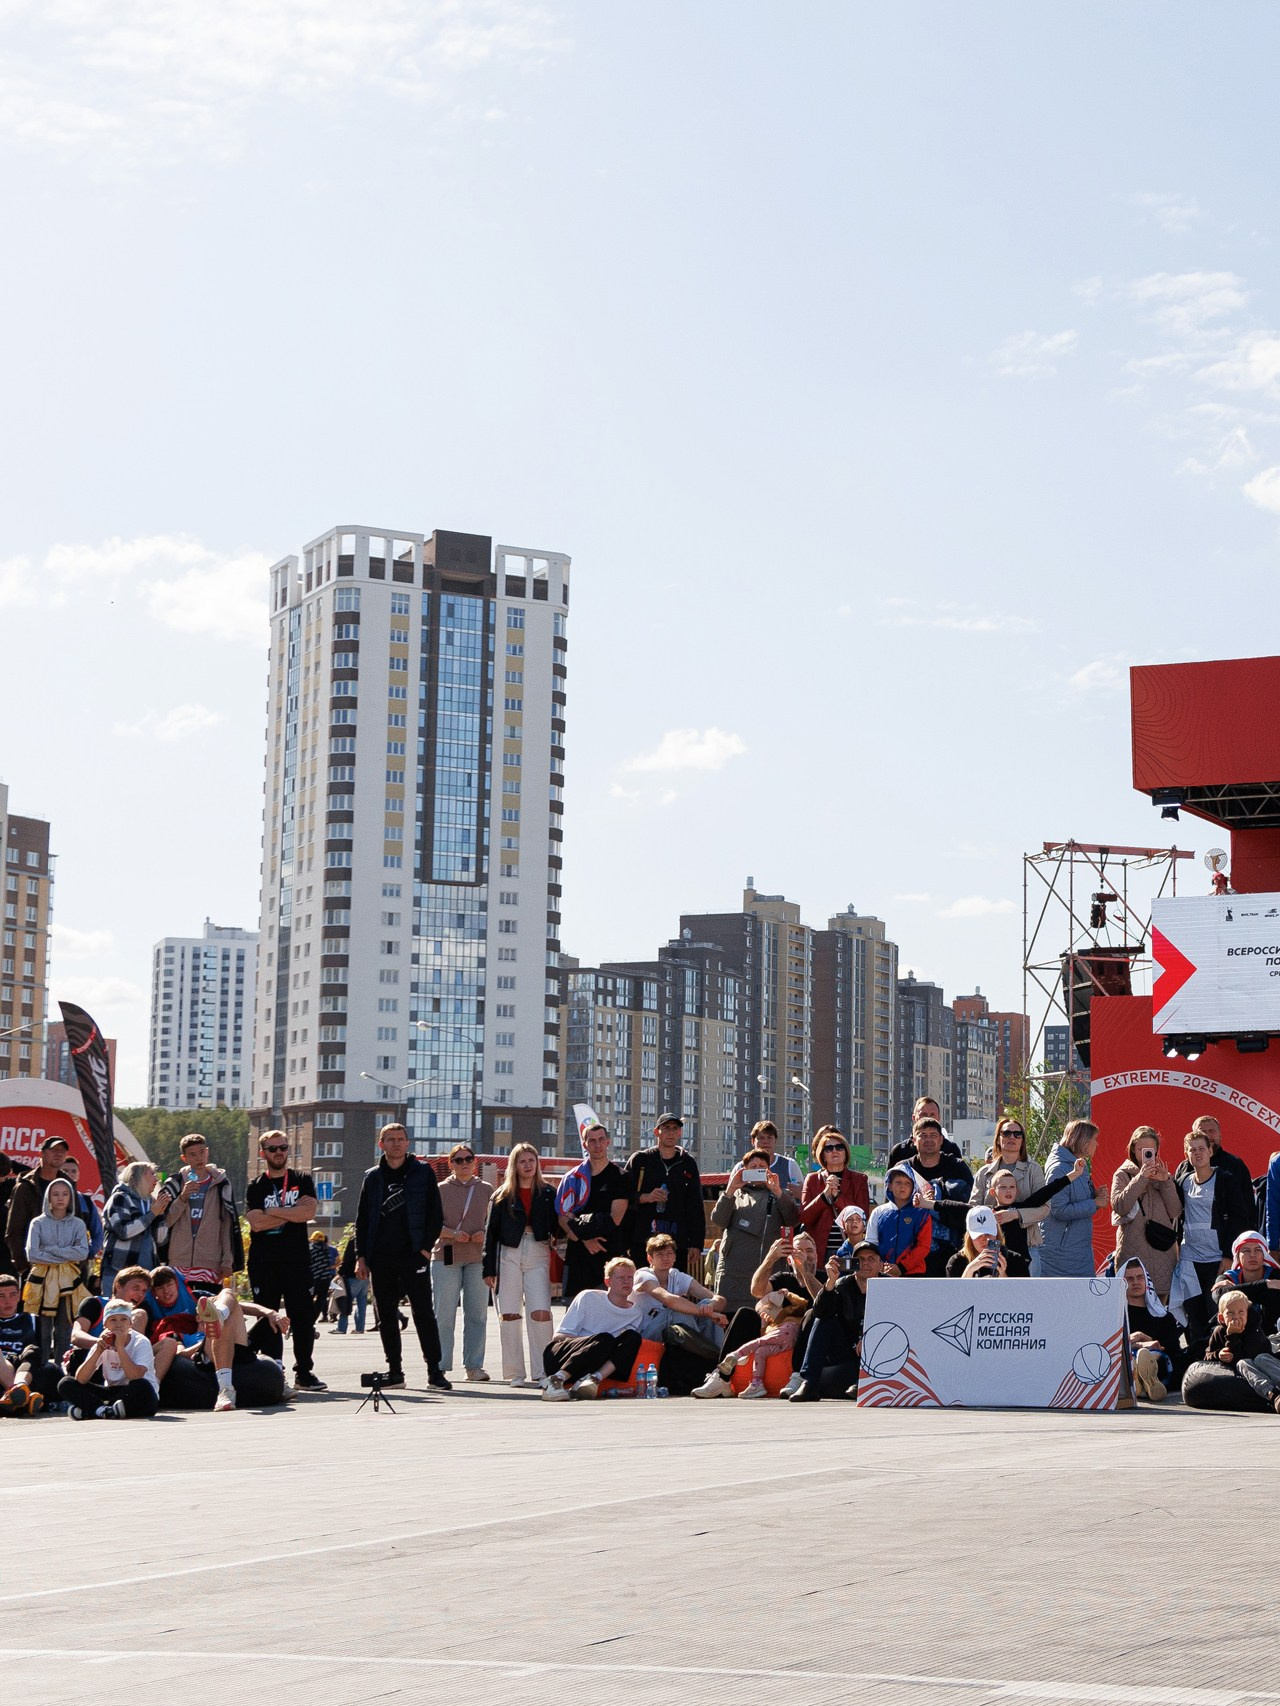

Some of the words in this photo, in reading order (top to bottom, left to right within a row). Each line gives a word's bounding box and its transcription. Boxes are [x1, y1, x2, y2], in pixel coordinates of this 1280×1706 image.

[1266, 957, 1280, 966] ПО
[1103, 1071, 1170, 1090] EXTREME
[1183, 1075, 1219, 1094] 2025
[1228, 1090, 1259, 1114] RCC
[0, 1126, 46, 1151] RCC
[978, 1312, 1033, 1323] РУССКАЯ
[977, 1326, 1030, 1336] МЕДНАЯ
[976, 1339, 1047, 1349] КОМПАНИЯ
